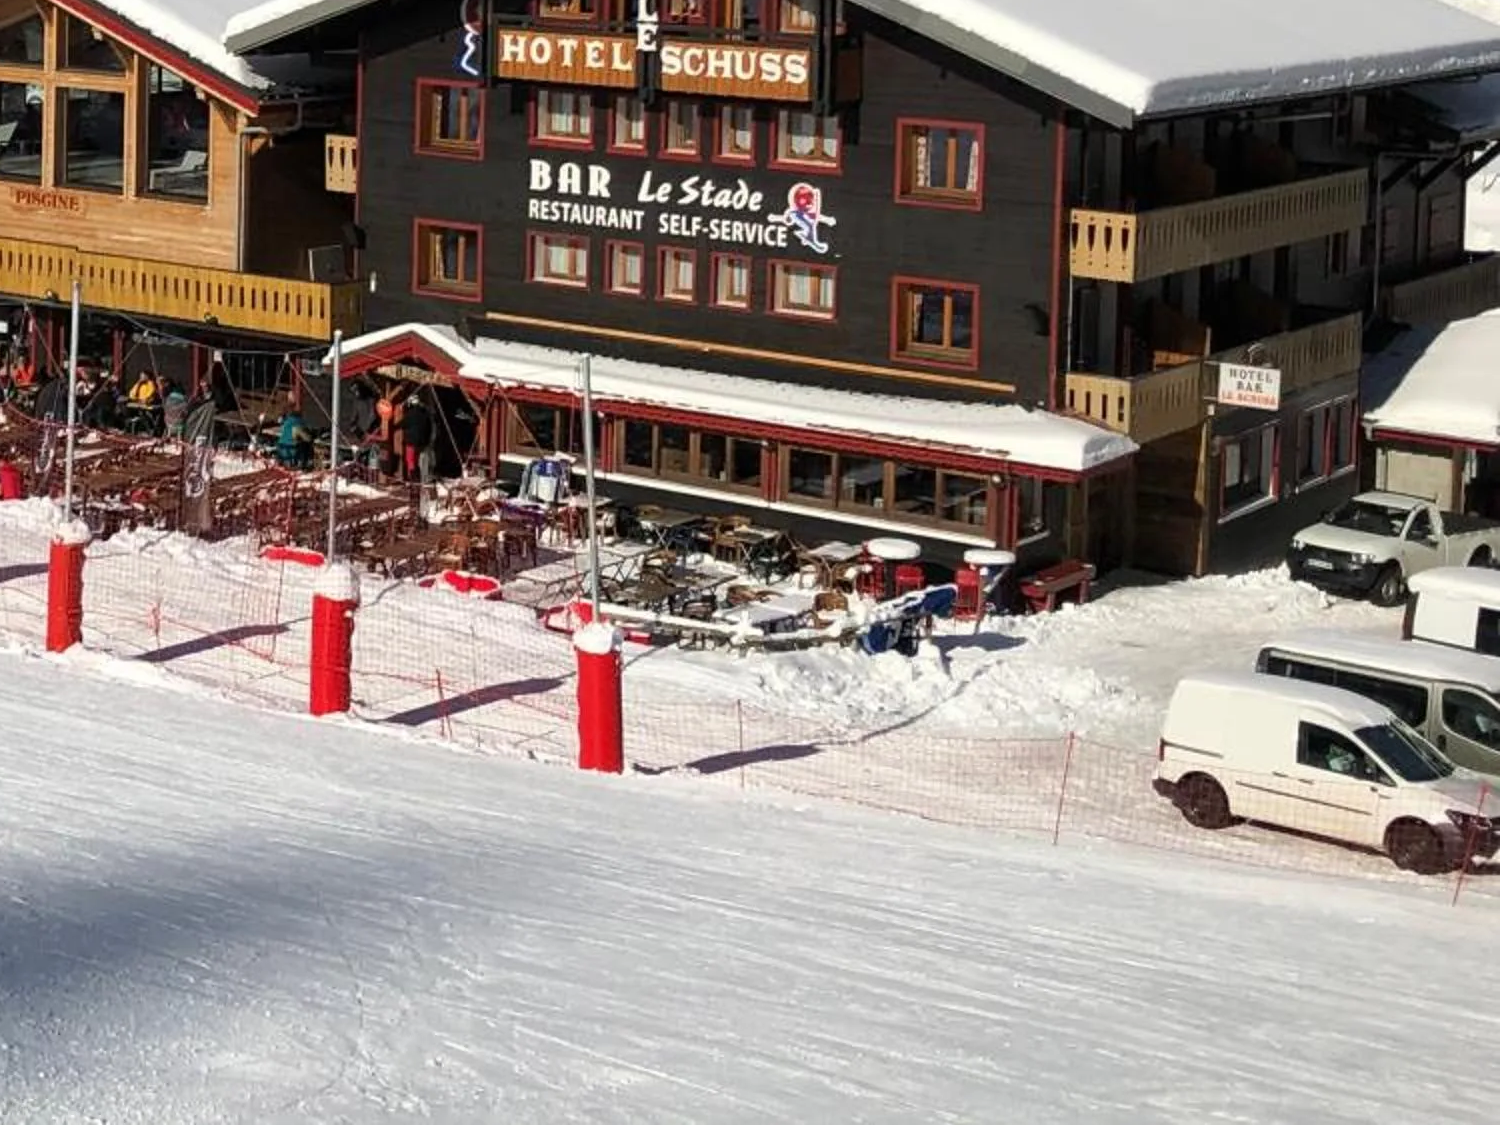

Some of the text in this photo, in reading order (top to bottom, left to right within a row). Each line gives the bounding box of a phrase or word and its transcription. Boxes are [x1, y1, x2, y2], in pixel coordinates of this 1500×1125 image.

[502, 34, 634, 72] HOTEL
[660, 45, 809, 84] SCHUSS
[529, 159, 763, 211] BAR Le Stade
[528, 198, 788, 248] RESTAURANT SELF-SERVICE
[1229, 368, 1273, 383] HOTEL
